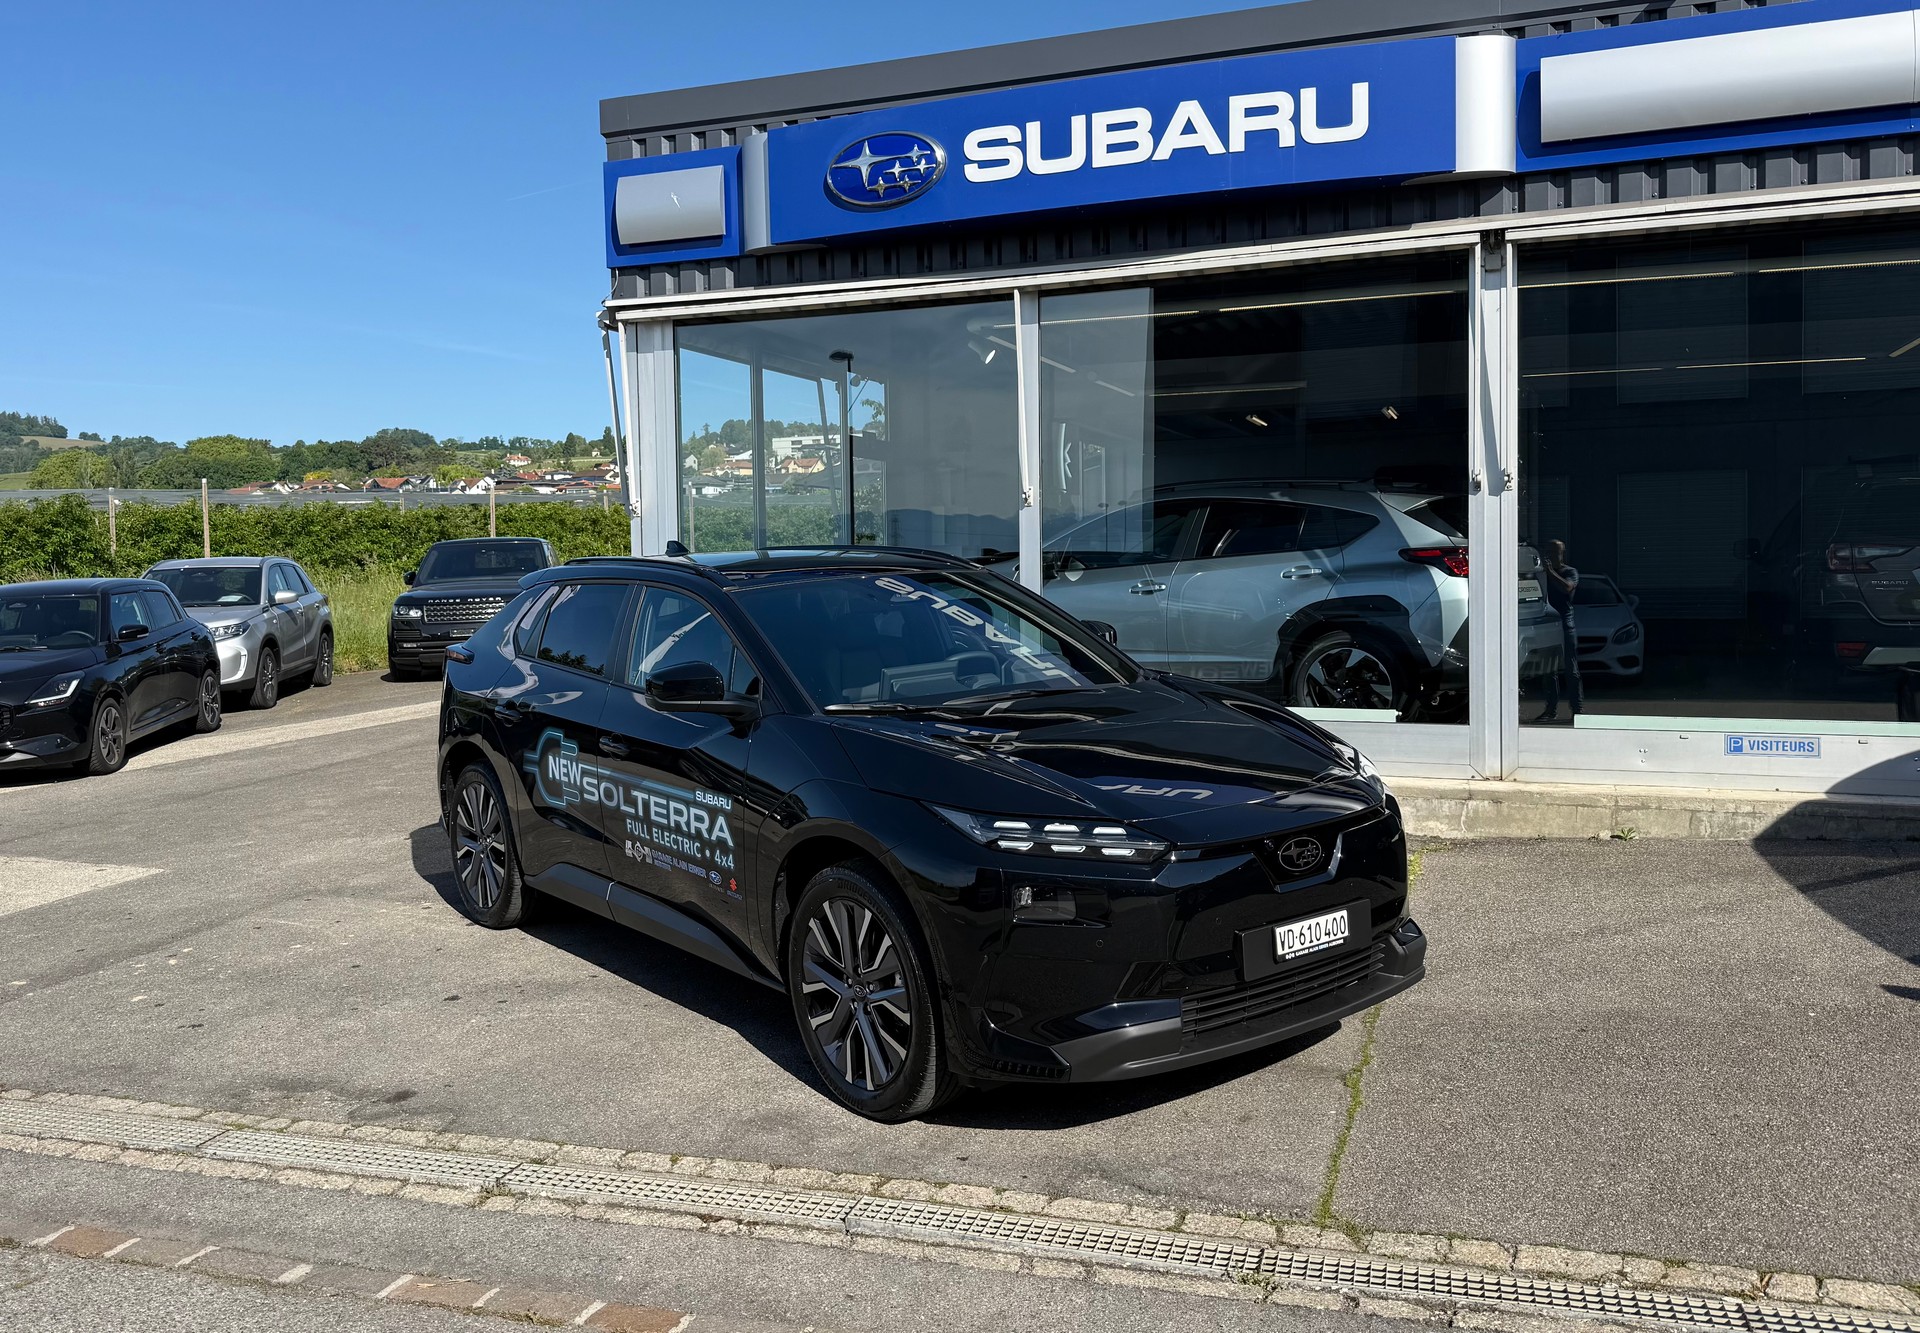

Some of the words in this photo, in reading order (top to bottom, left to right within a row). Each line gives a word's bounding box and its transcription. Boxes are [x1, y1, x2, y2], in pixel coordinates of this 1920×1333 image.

[963, 82, 1369, 183] SUBARU
[1730, 738, 1742, 751] P
[1748, 740, 1815, 752] VISITEURS
[549, 755, 582, 786] NEW
[582, 777, 734, 847] SOLTERRA
[696, 790, 731, 810] SUBARU
[626, 818, 650, 840] FULL
[652, 827, 701, 858] ELECTRIC
[714, 849, 735, 870] 4x4
